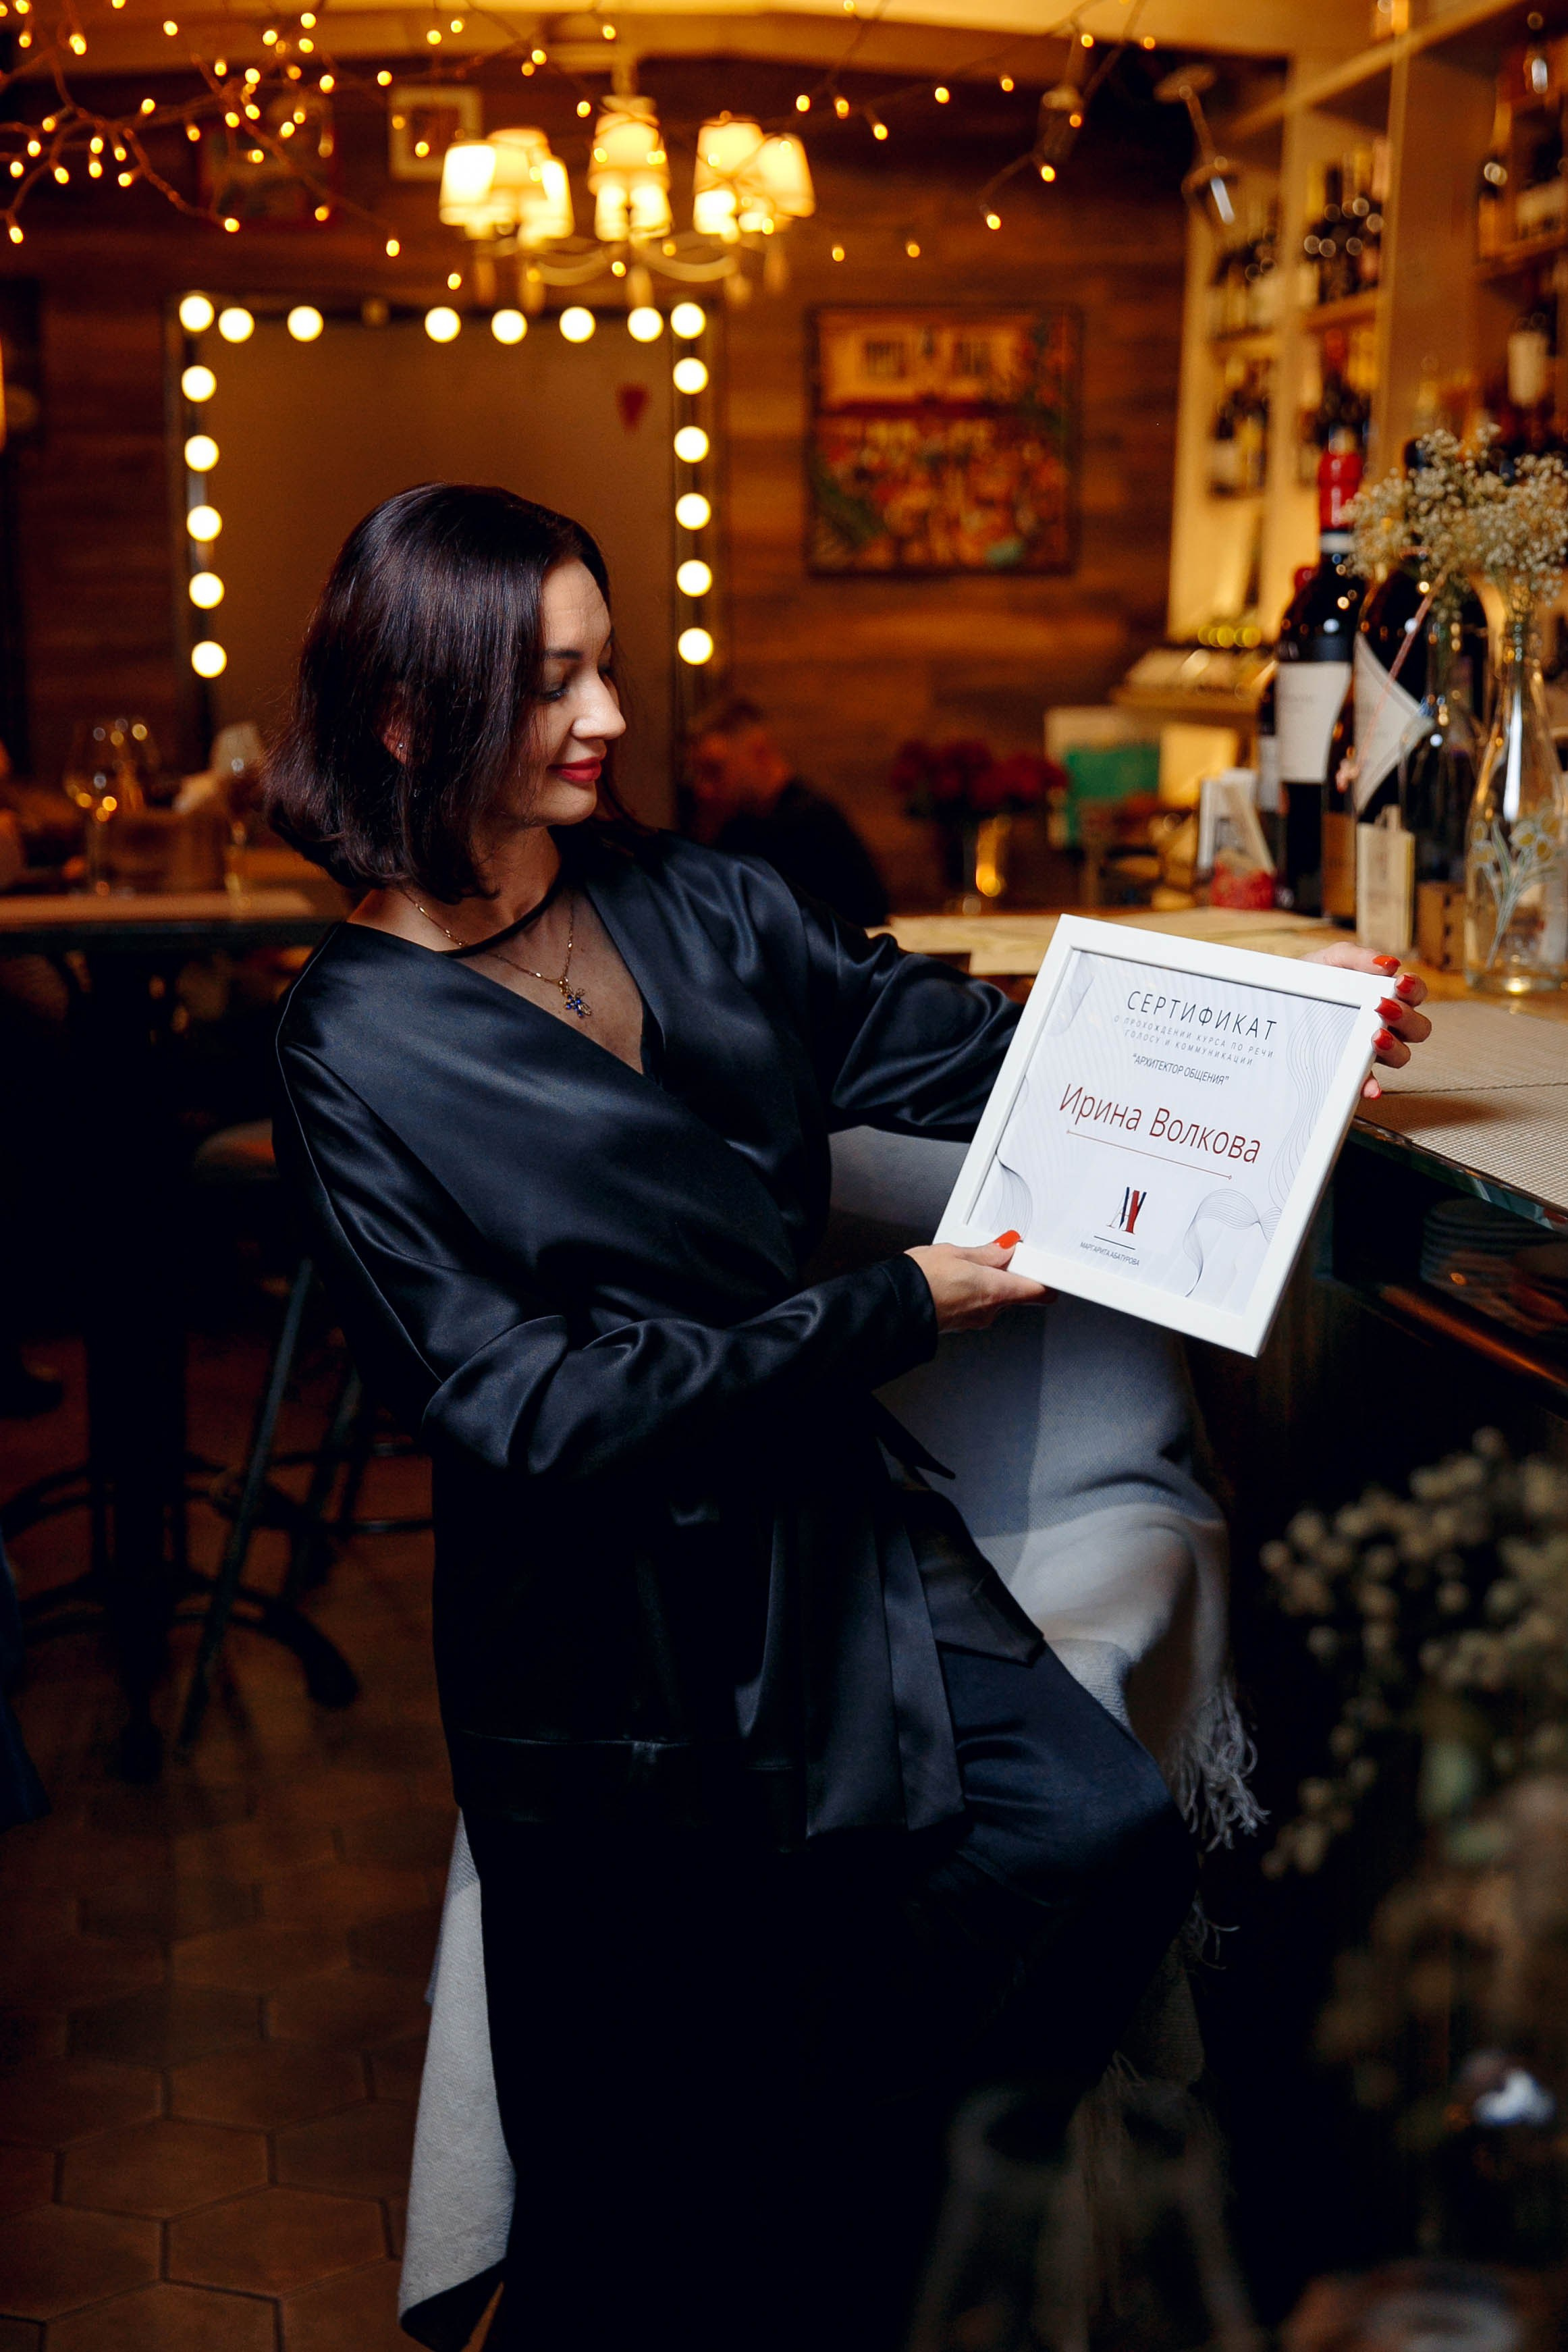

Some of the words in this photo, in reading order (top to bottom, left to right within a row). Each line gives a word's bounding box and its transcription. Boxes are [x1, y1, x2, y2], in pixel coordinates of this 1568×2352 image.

[1128, 991, 1277, 1040] СЕРТИФИКАТ
[1123, 1017, 1192, 1039] ПРОХОЖДЕНИИ
[1197, 1035, 1226, 1047] КУРСА
[1231, 1042, 1243, 1051] ПО
[1248, 1046, 1274, 1059] РЕЧИ
[1124, 1030, 1160, 1044] ГОЛОСУ
[1175, 1042, 1253, 1066] КОММУНИКАЦИИ
[1059, 1084, 1142, 1131] Ирина
[1149, 1107, 1261, 1164] Волкова
[1079, 1241, 1110, 1256] МАРГАРИТА
[1110, 1252, 1140, 1266] АБАТУРОВА
